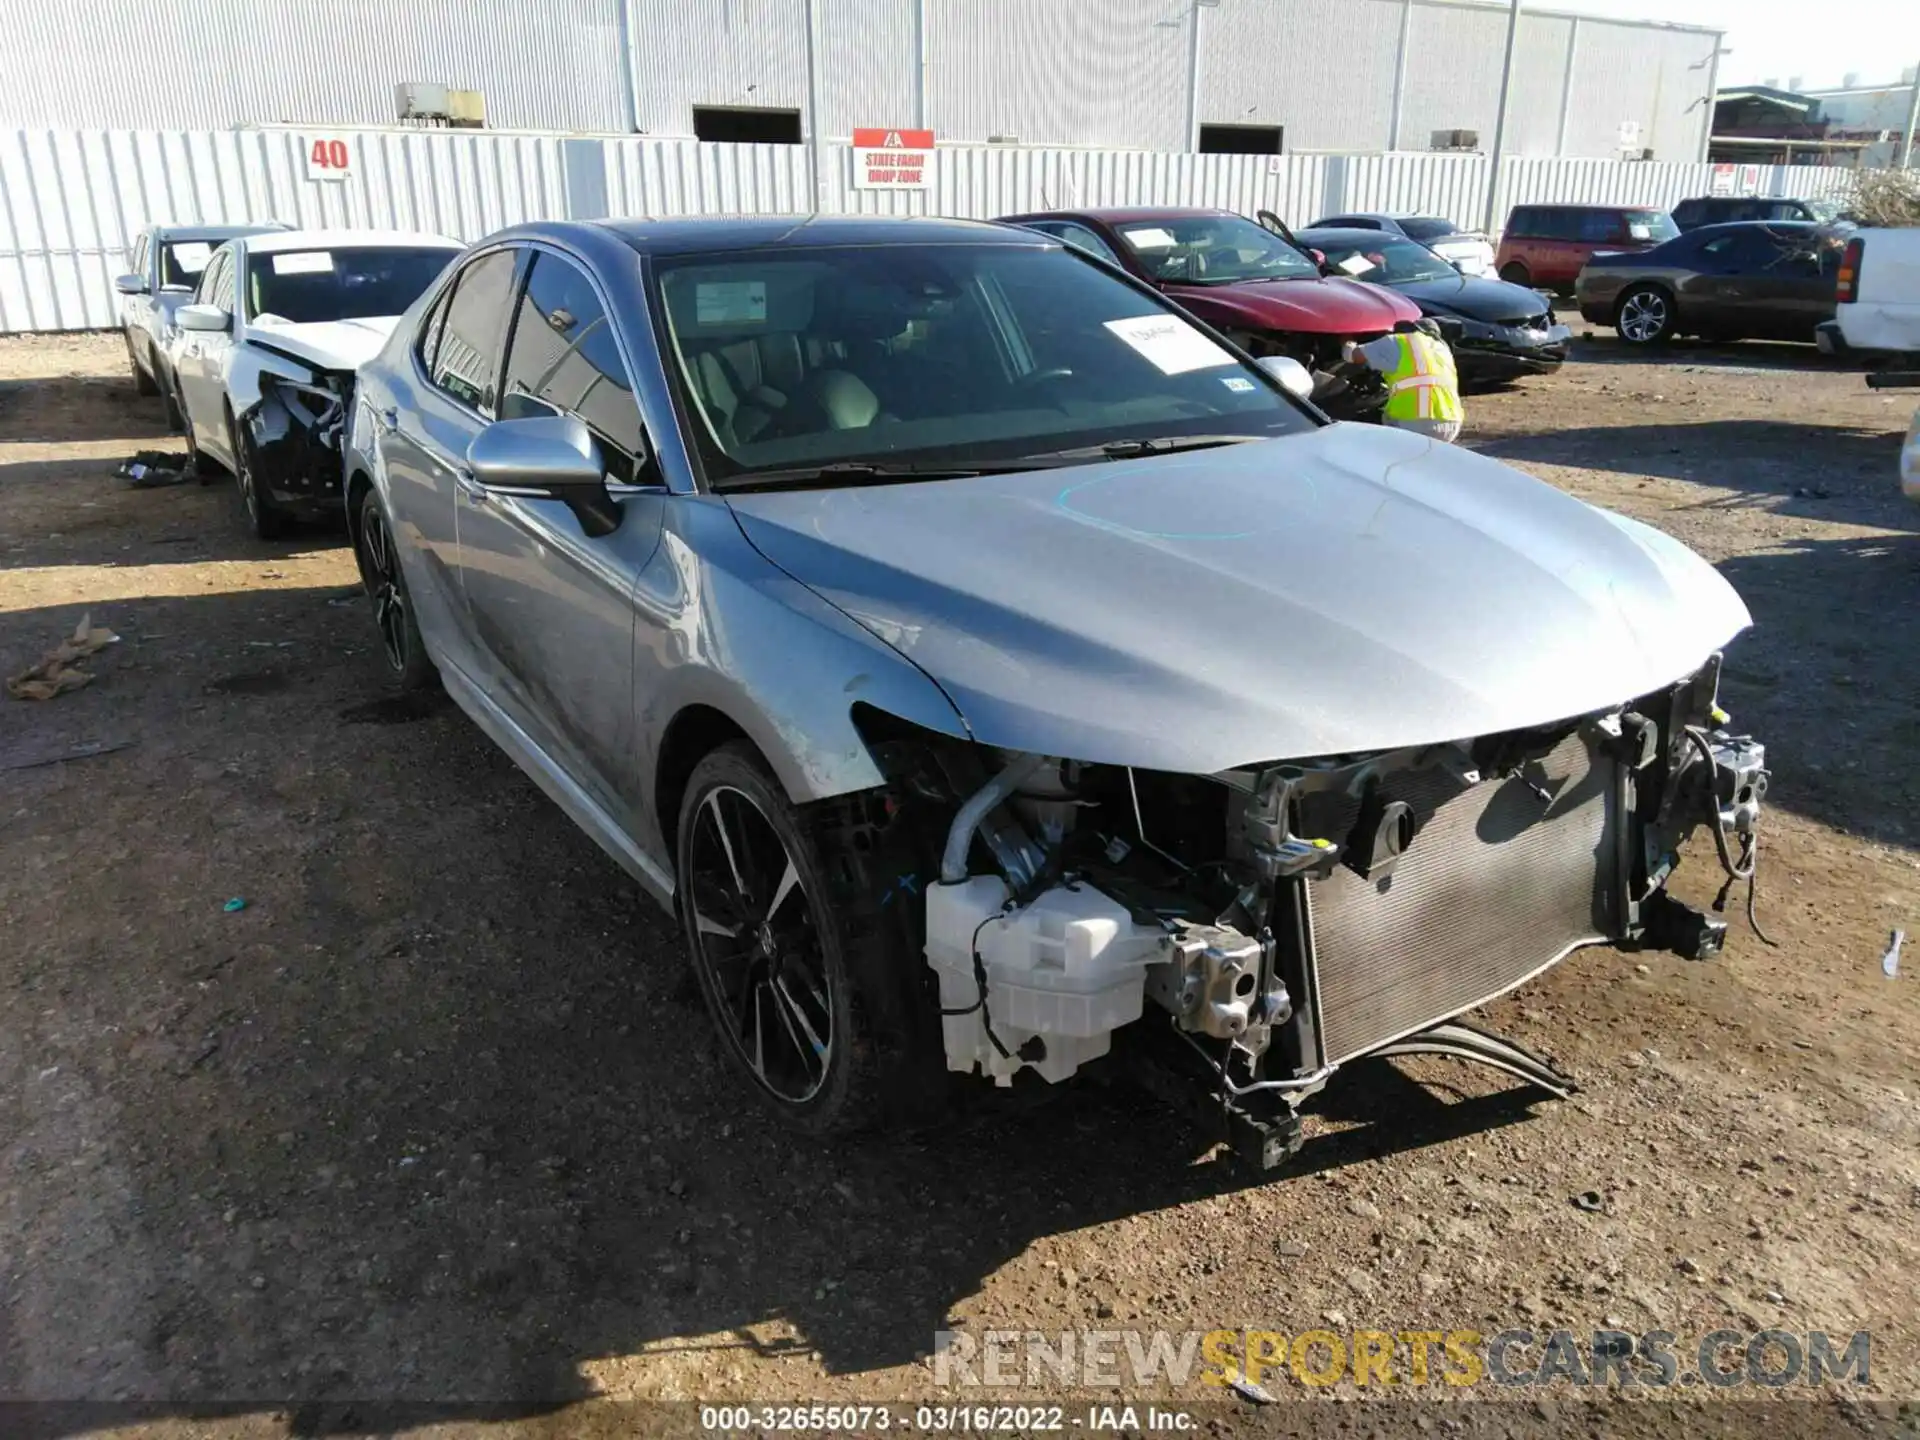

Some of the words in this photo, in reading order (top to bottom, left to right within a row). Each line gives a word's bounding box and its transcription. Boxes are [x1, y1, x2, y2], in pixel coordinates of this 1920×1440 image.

[312, 140, 349, 168] 40
[865, 153, 896, 167] STATE
[897, 153, 925, 167] FARM
[868, 169, 896, 183] DROP
[897, 169, 923, 183] ZONE
